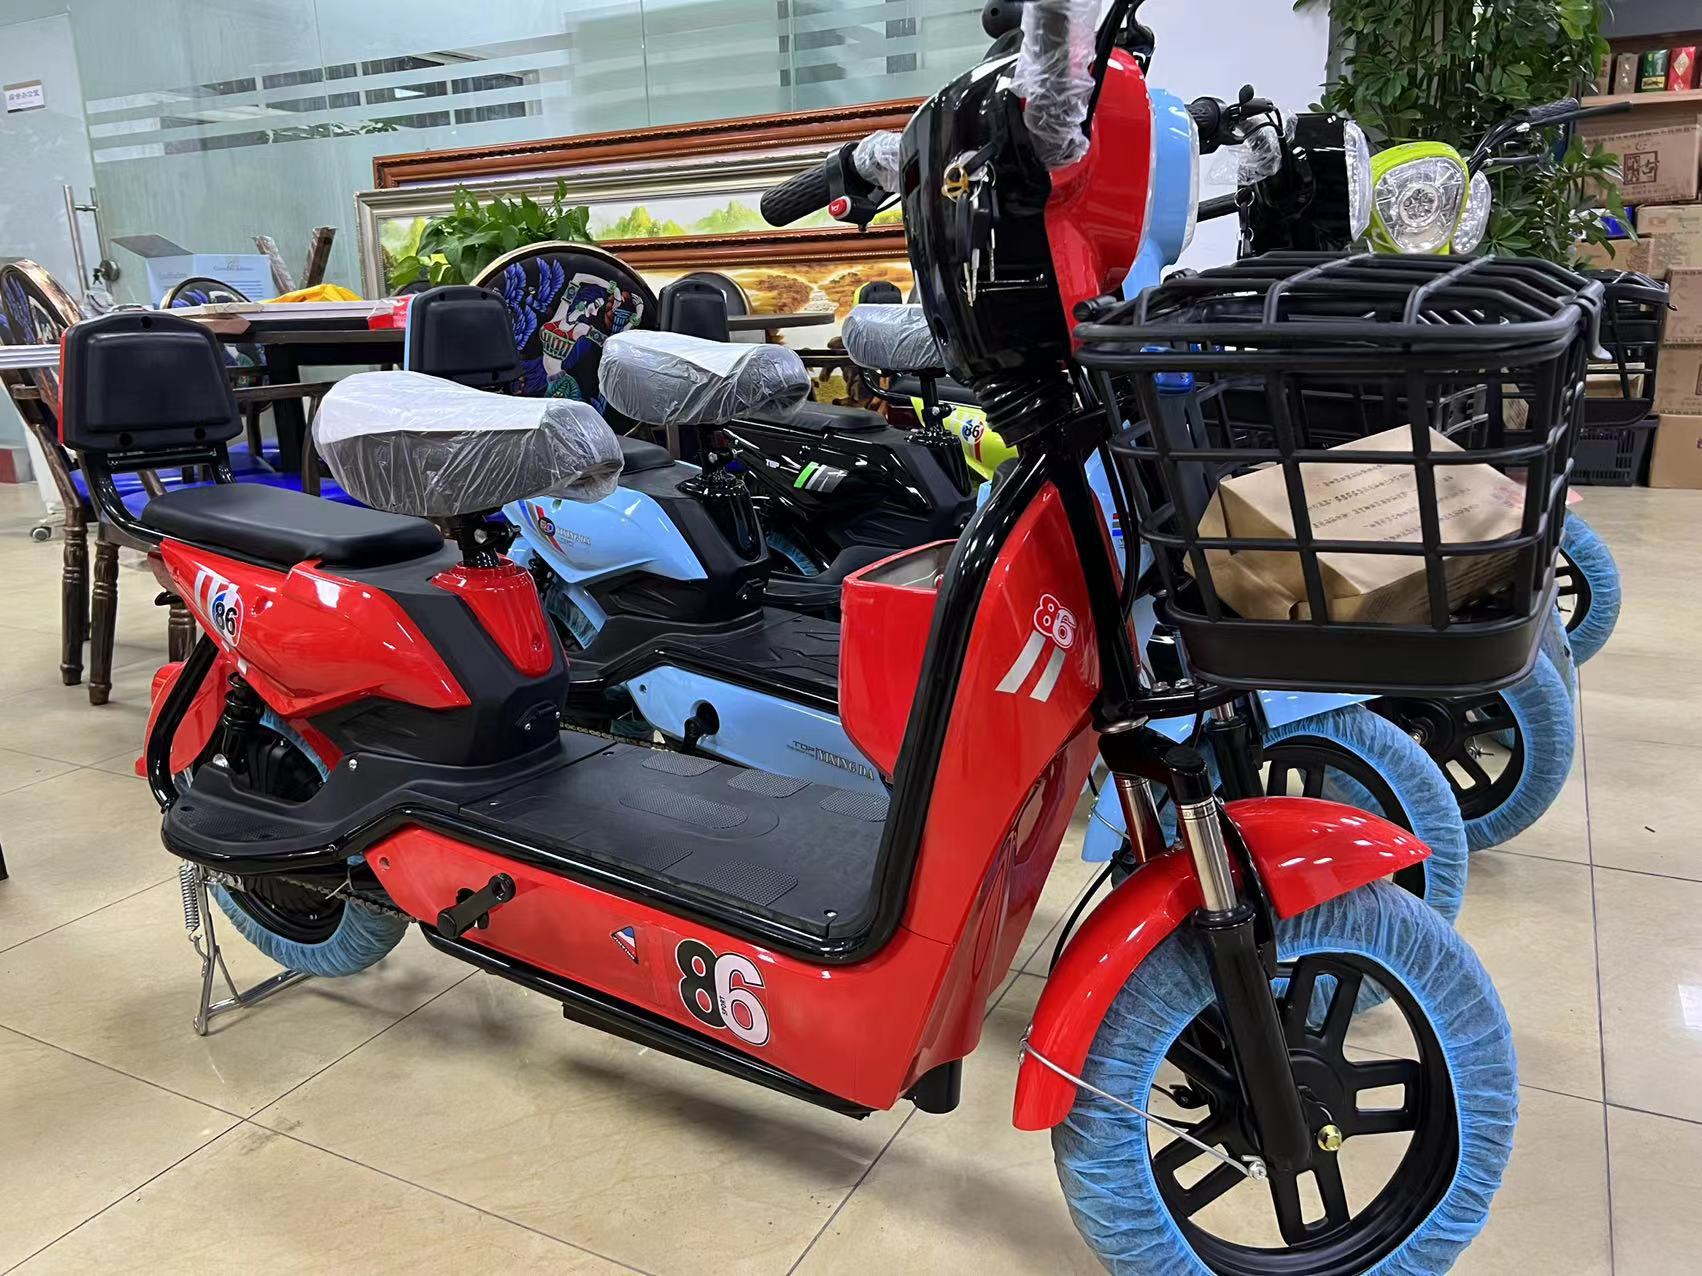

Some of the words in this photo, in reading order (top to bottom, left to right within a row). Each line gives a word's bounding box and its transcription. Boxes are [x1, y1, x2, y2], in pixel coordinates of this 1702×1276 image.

[215, 601, 238, 636] 86
[1034, 594, 1077, 649] 86
[675, 938, 770, 1047] 86
